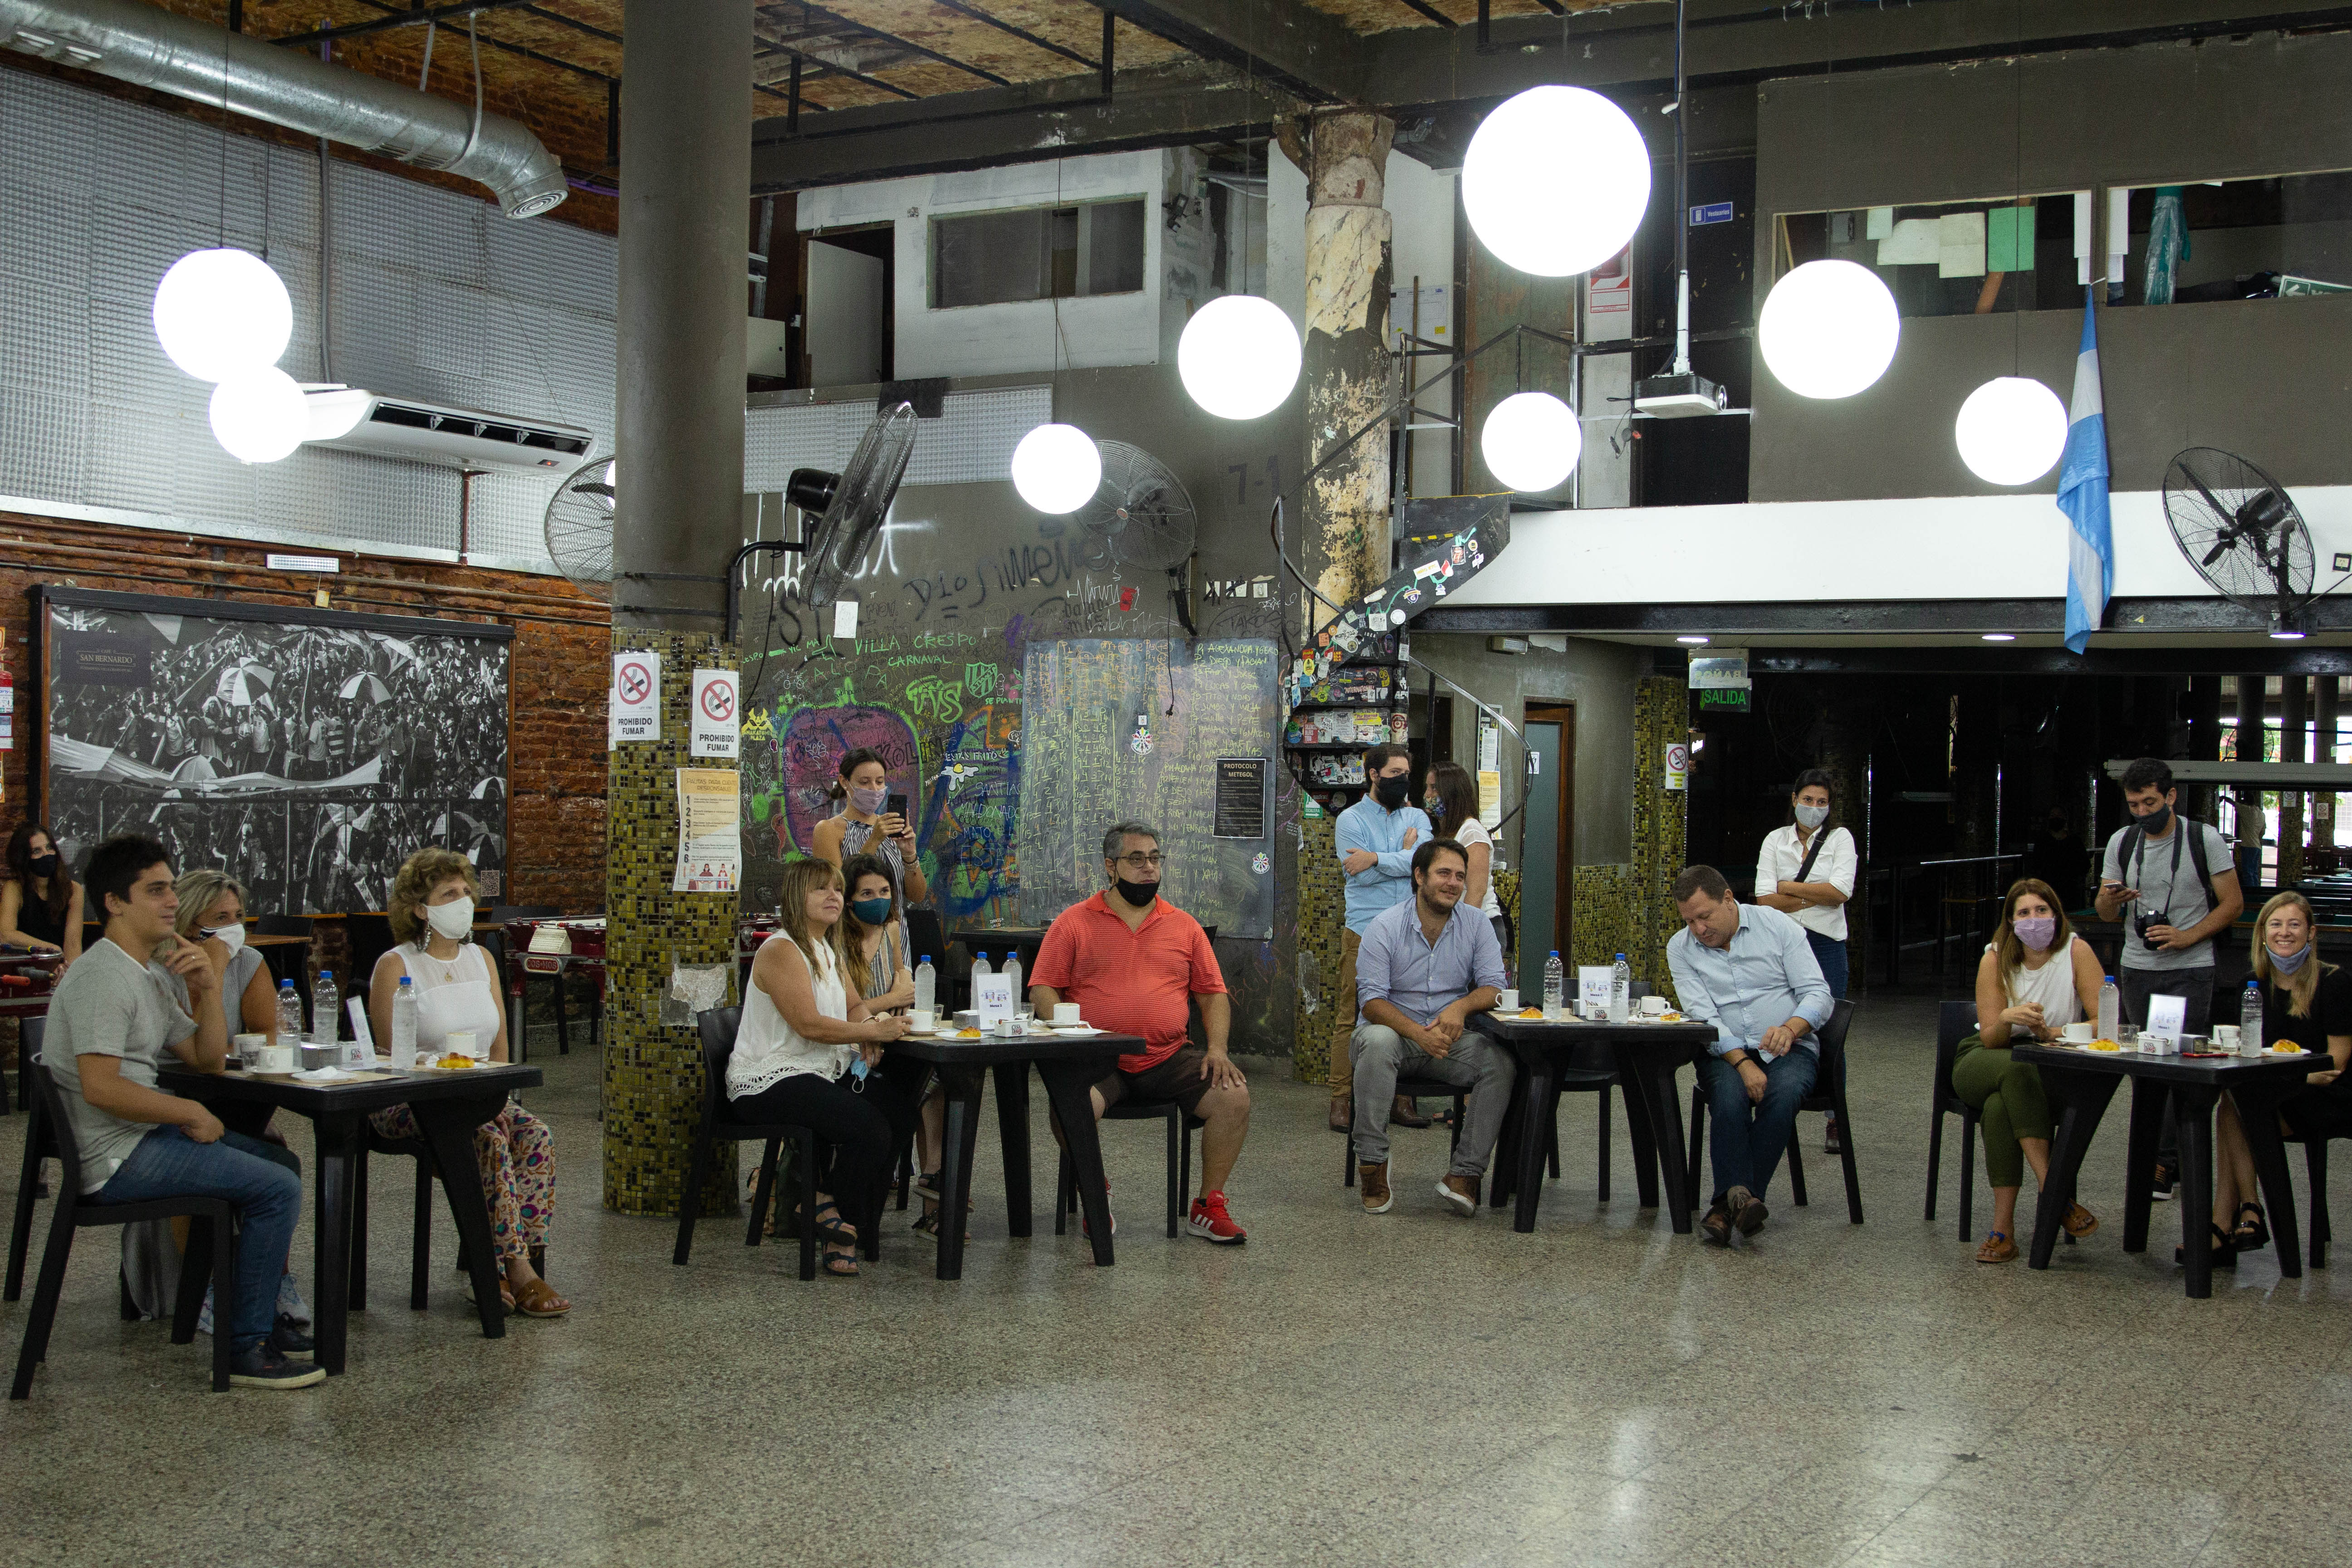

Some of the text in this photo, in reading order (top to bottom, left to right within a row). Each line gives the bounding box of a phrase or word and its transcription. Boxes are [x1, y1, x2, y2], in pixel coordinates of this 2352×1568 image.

[1707, 209, 1730, 217] Vestuarios
[855, 634, 977, 656] VILLA CRESPO
[95, 655, 132, 663] BERNARDO
[888, 654, 953, 667] CARNAVAL
[1205, 682, 1230, 691] LUCAS
[1202, 692, 1221, 701] TITO
[1703, 690, 1746, 705] SALIDA
[618, 717, 652, 726] PROHIBIDO
[622, 727, 645, 735] FUMAR
[699, 734, 735, 743] PROHIBIDO
[707, 743, 730, 752] FUMAR
[973, 751, 999, 760] FRITO
[1205, 748, 1236, 758] WALTER
[1247, 747, 1263, 757] YAS
[686, 795, 690, 804] 1
[686, 807, 691, 816] 2
[686, 819, 691, 828] 3
[686, 830, 690, 839] 4
[685, 842, 689, 851] 5
[1197, 841, 1215, 857] TOMY
[684, 854, 689, 863] 6
